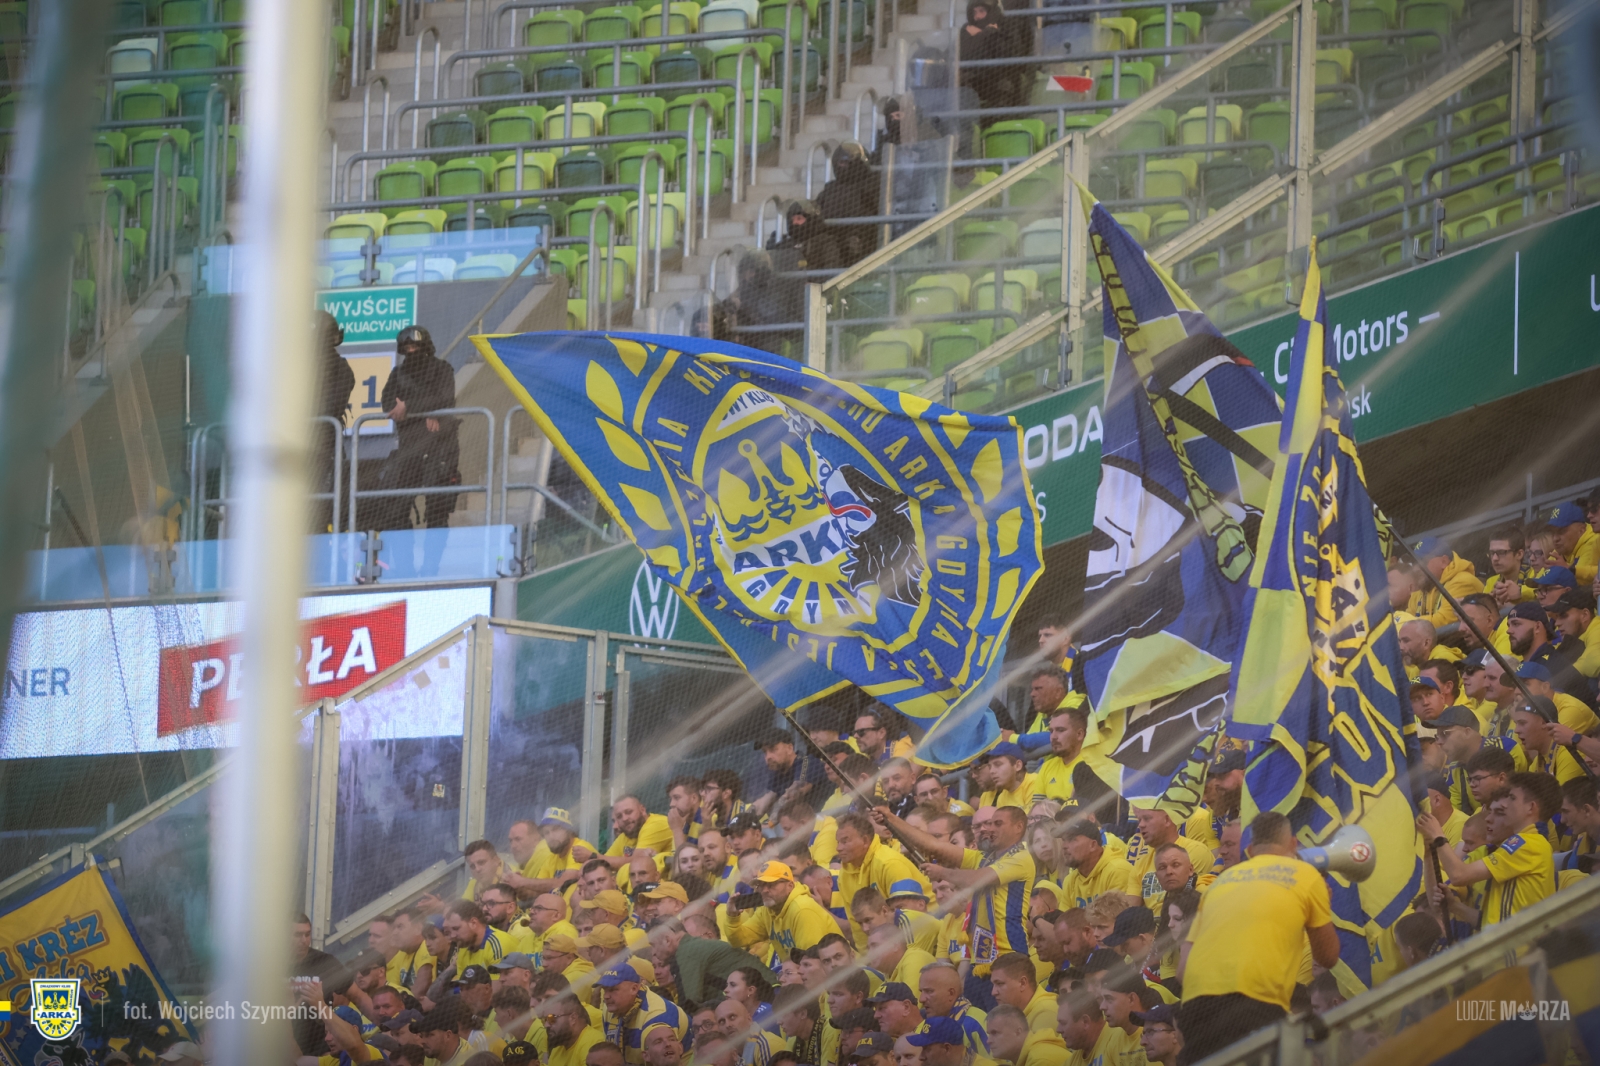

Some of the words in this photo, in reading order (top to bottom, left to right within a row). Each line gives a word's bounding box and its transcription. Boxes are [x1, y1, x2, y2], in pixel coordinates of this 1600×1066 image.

[324, 296, 407, 317] WYJŚCIE
[338, 318, 410, 334] AKUACYJNE
[1023, 405, 1104, 469] ODA
[188, 626, 378, 709] PEŁA
